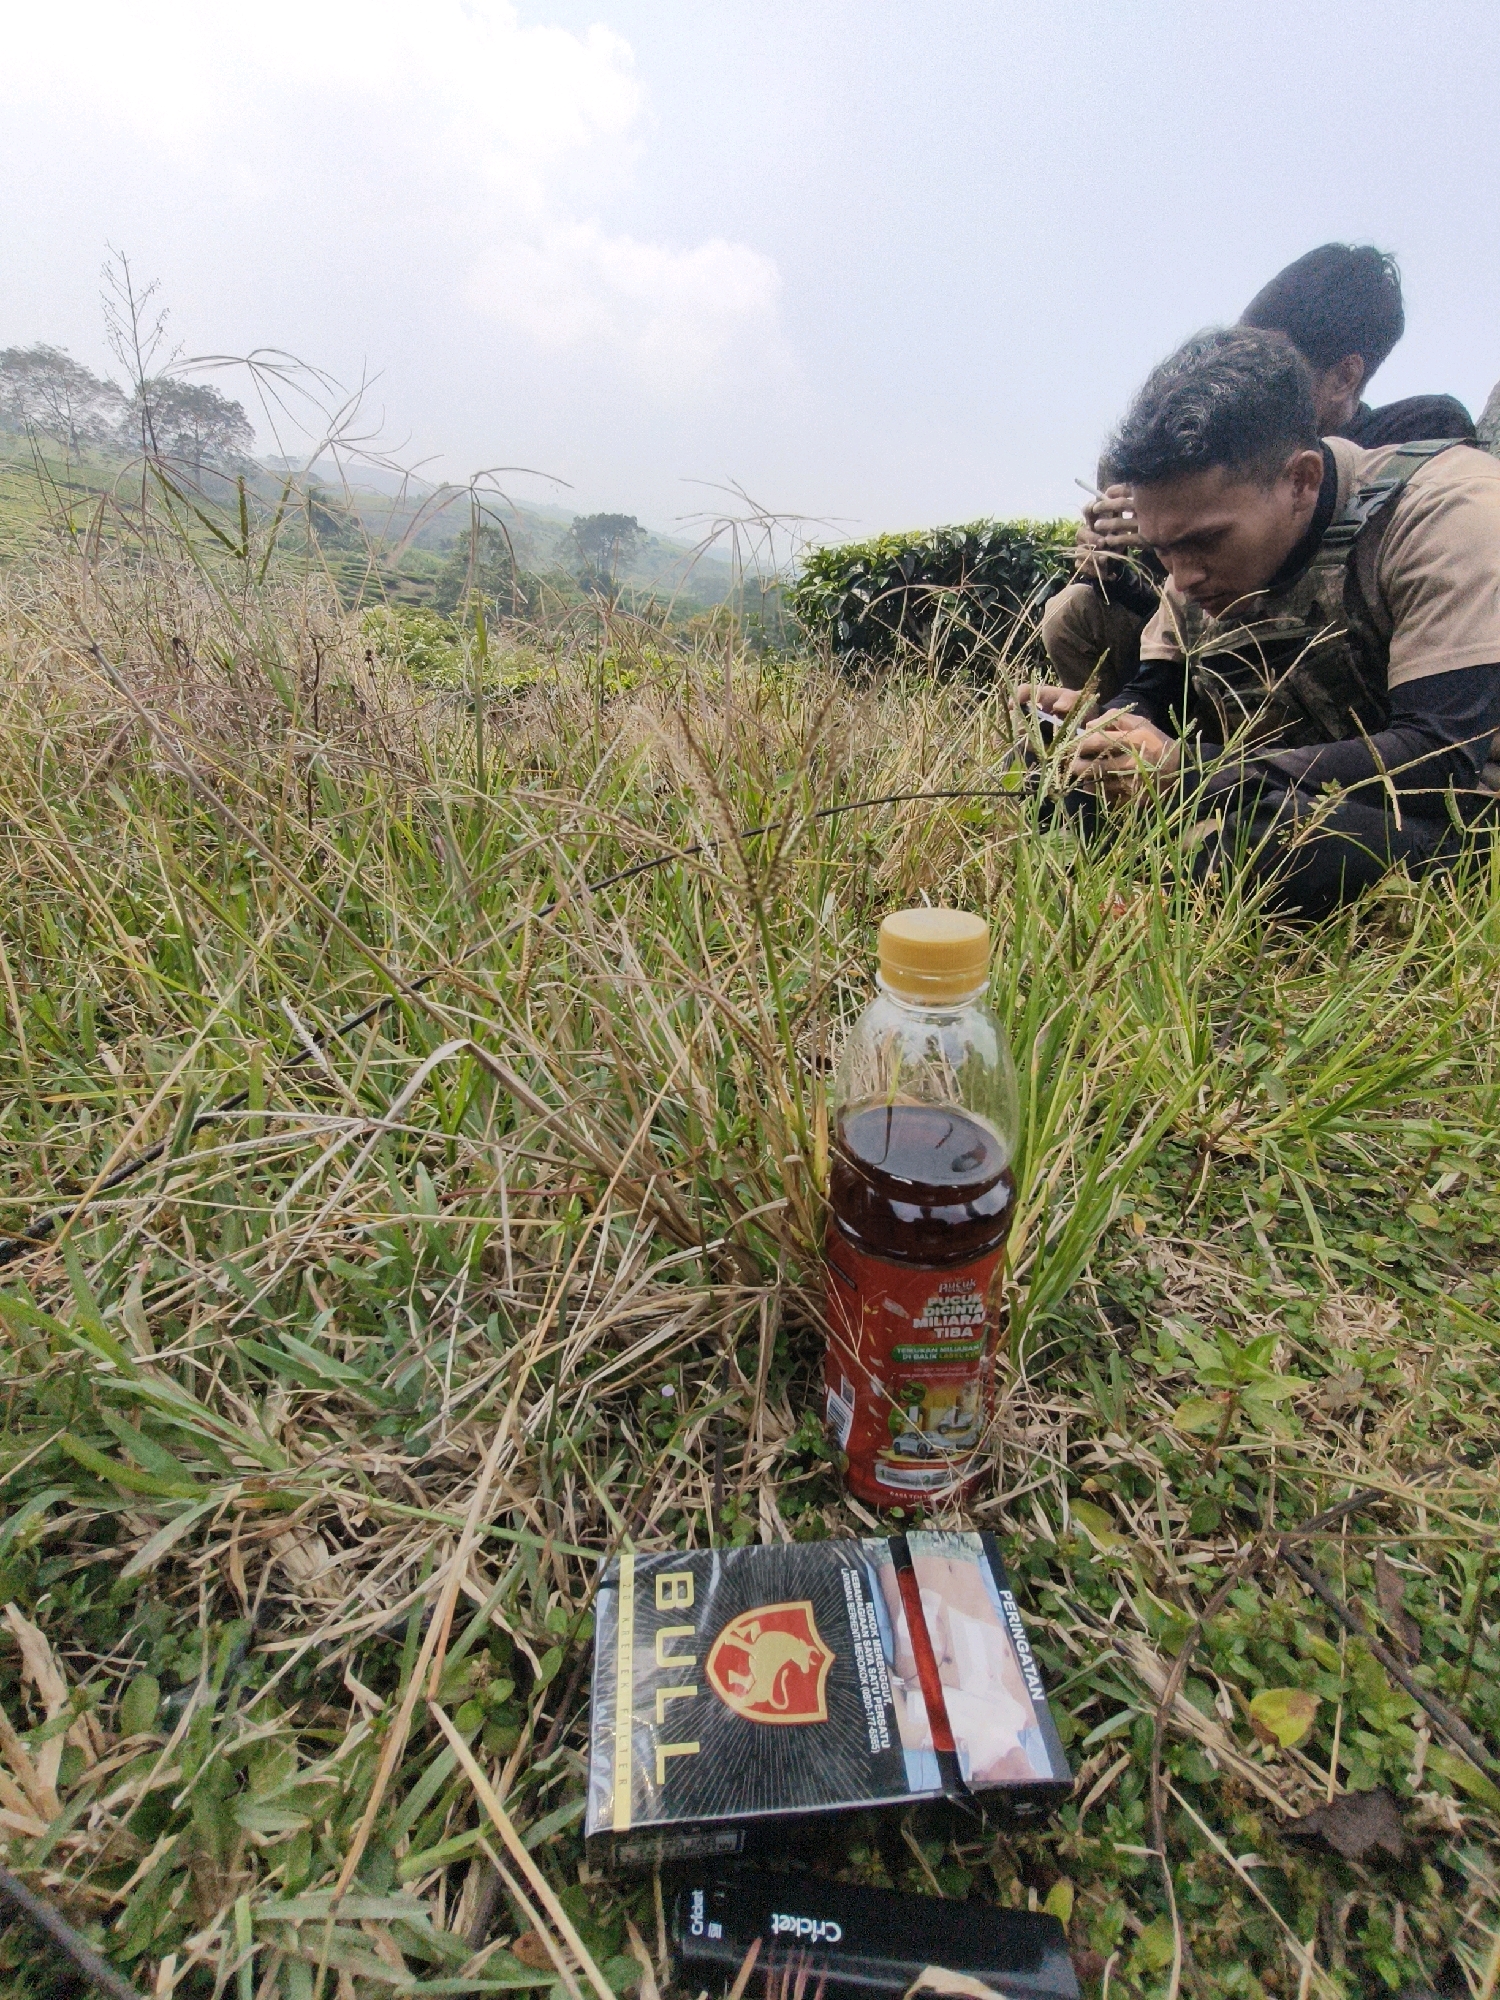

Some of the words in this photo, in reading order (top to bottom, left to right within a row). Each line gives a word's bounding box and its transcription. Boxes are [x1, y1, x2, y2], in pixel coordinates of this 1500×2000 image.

[923, 1303, 984, 1317] DICINTA
[927, 1293, 983, 1306] PUCUK
[934, 1326, 974, 1339] TIBA
[841, 1568, 854, 1601] LAYANAN
[850, 1569, 870, 1638] KEBAHAGIAAN
[846, 1602, 861, 1642] BERHENTI
[865, 1602, 879, 1638] ROKOK
[620, 1617, 631, 1688] KRETEK
[854, 1642, 870, 1686] MEROKOK
[863, 1639, 875, 1666] SAYA
[999, 1589, 1045, 1701] PERINGATAN
[655, 1571, 700, 1785] BULL
[868, 1667, 880, 1695] SATU
[873, 1696, 891, 1749] PERSATU
[618, 1708, 630, 1786] FILTER
[771, 1913, 842, 1943] Cricket
